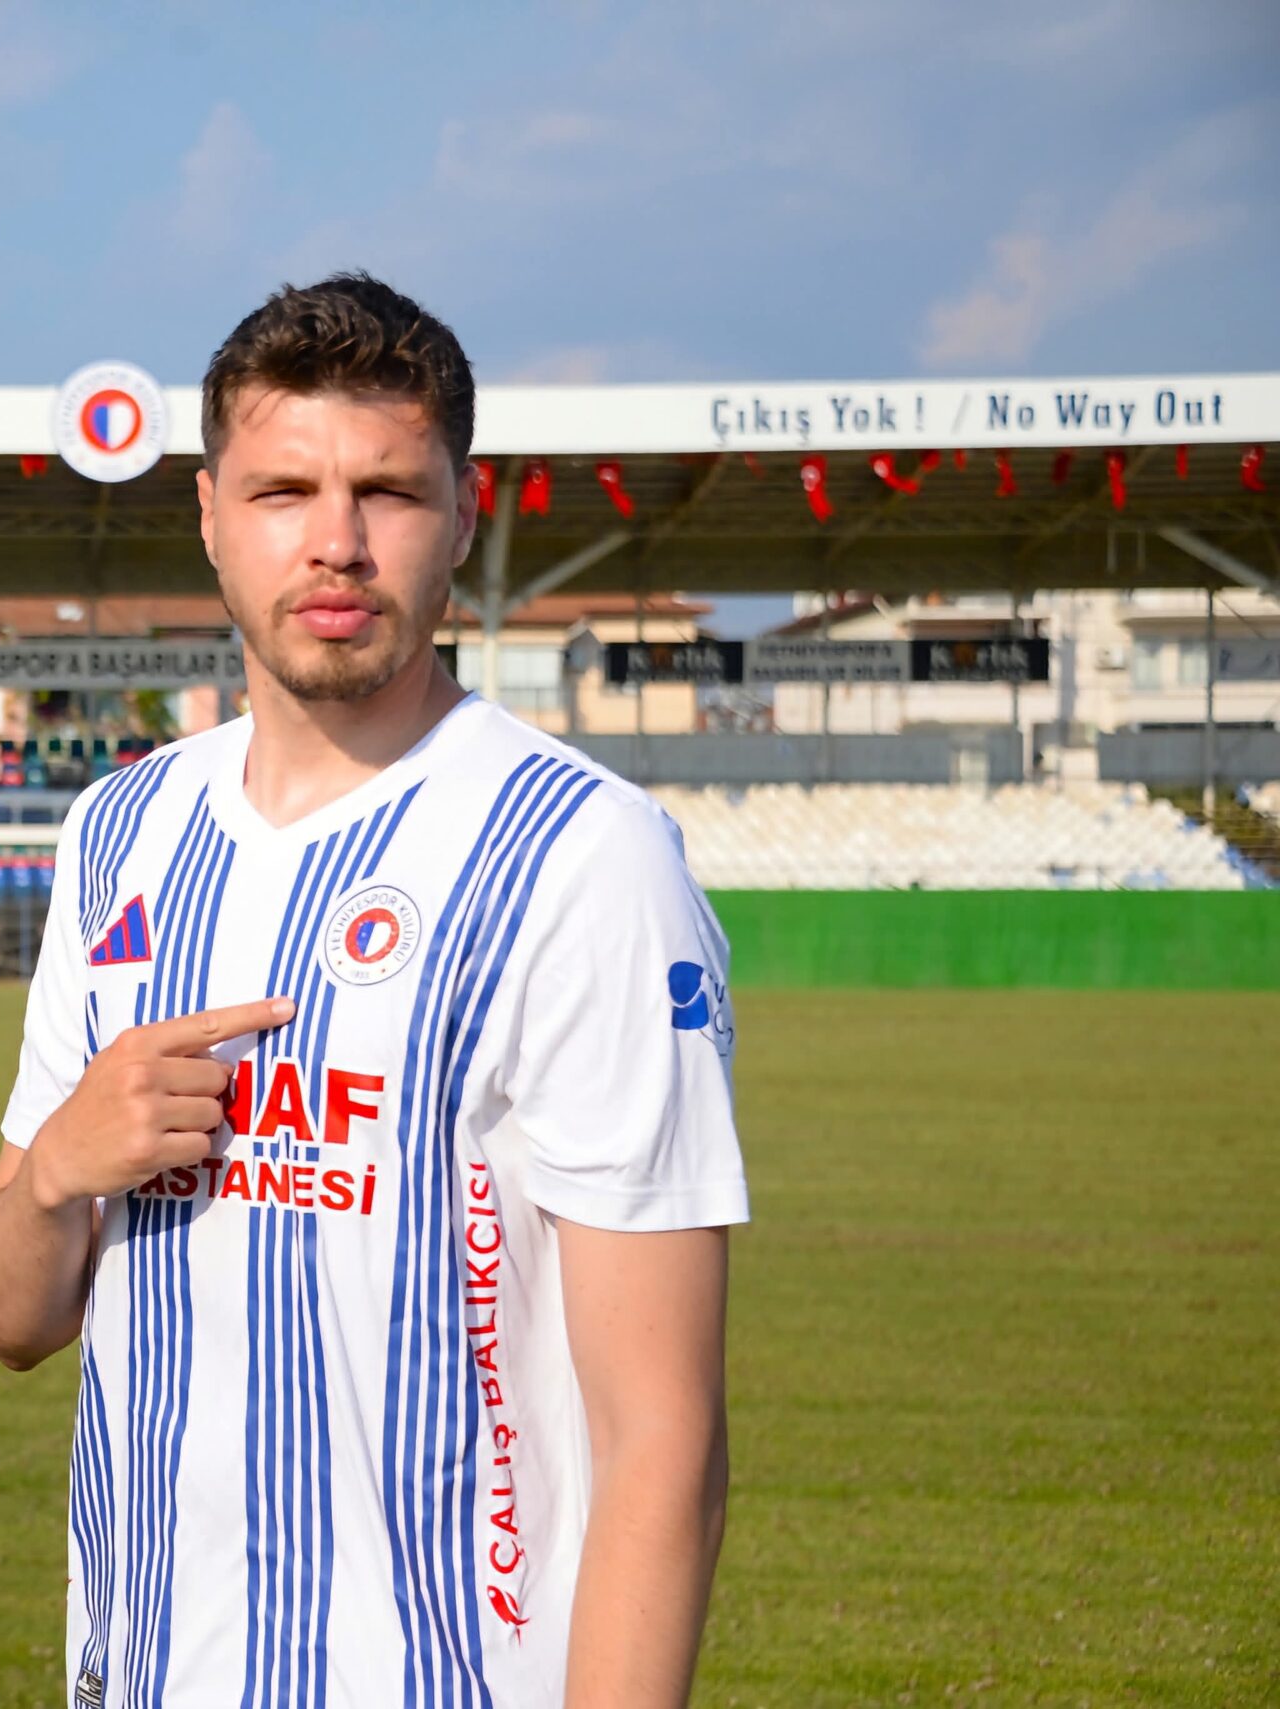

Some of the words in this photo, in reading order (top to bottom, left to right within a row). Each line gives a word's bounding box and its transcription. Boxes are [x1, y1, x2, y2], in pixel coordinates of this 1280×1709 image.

[830, 396, 897, 433] Yok
[988, 393, 1036, 431] No
[1055, 393, 1136, 435] Way
[1155, 389, 1224, 427] Out
[138, 1157, 377, 1216] ASTANESİ
